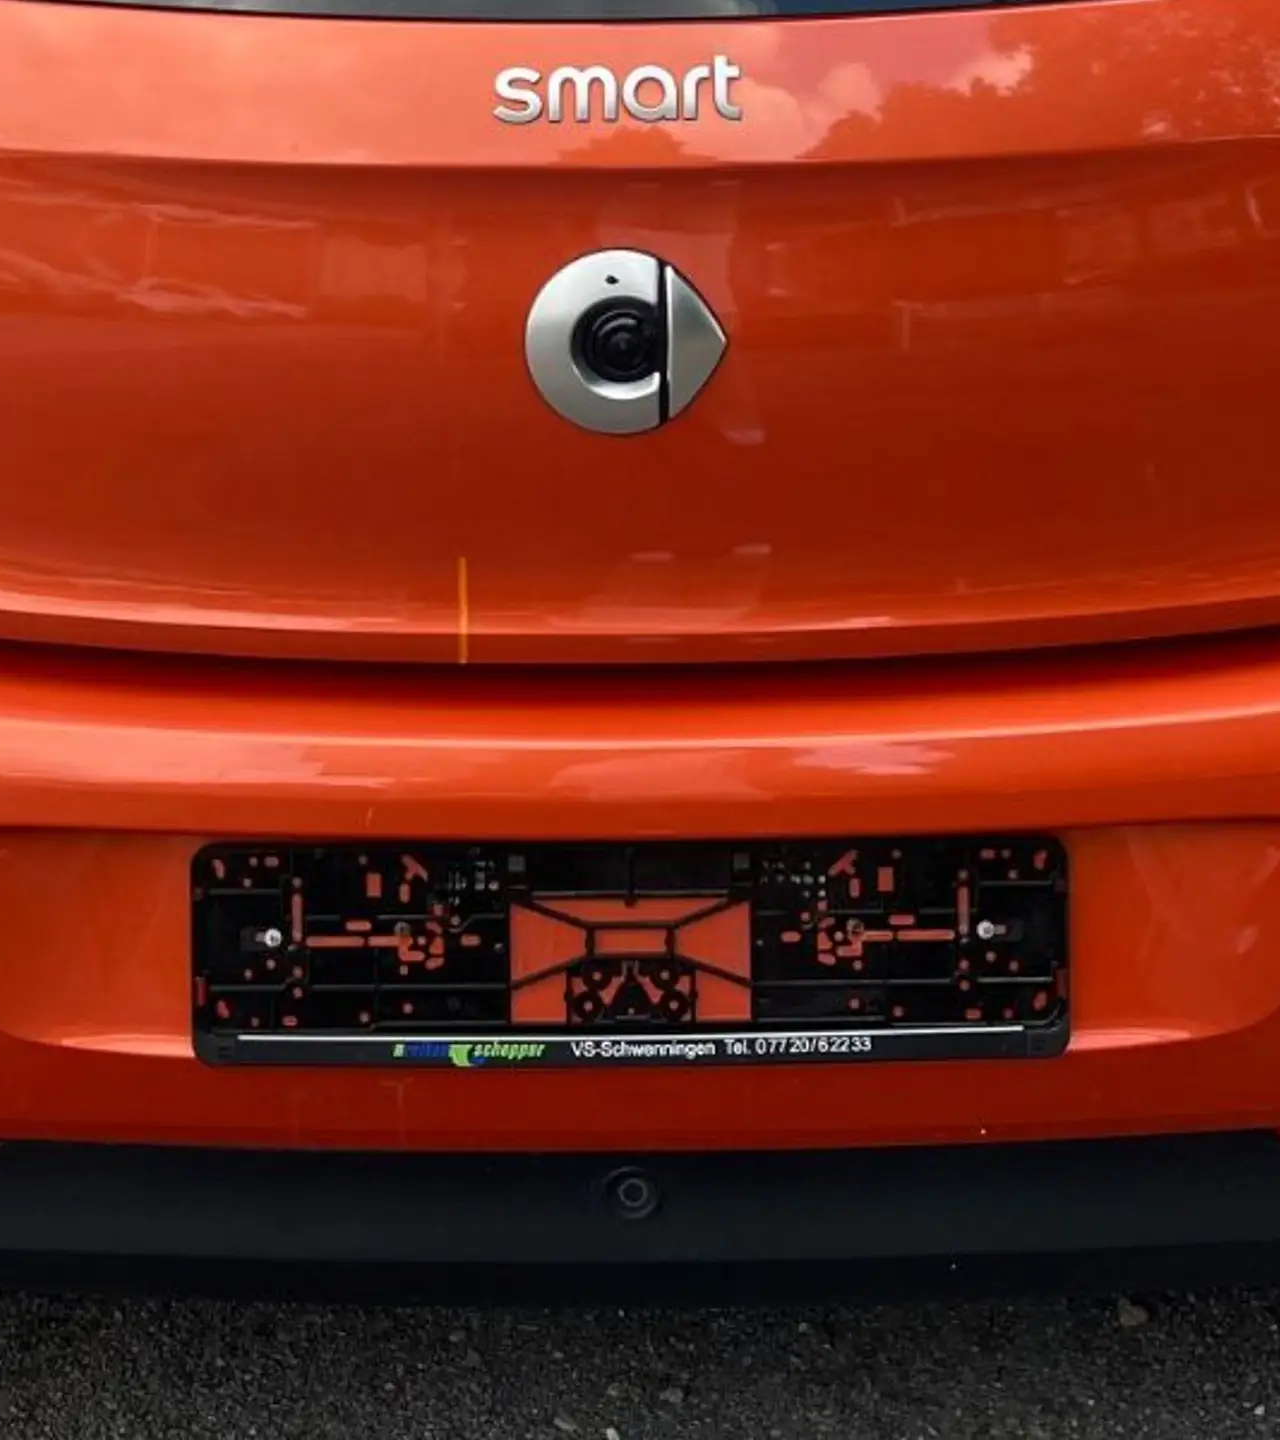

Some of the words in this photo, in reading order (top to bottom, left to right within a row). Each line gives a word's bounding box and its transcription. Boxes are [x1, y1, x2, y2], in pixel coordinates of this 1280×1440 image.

[492, 54, 743, 124] smart
[570, 1039, 716, 1060] VS-Schwenningen
[723, 1037, 752, 1056] Tel.
[755, 1035, 873, 1056] 07720/62233
